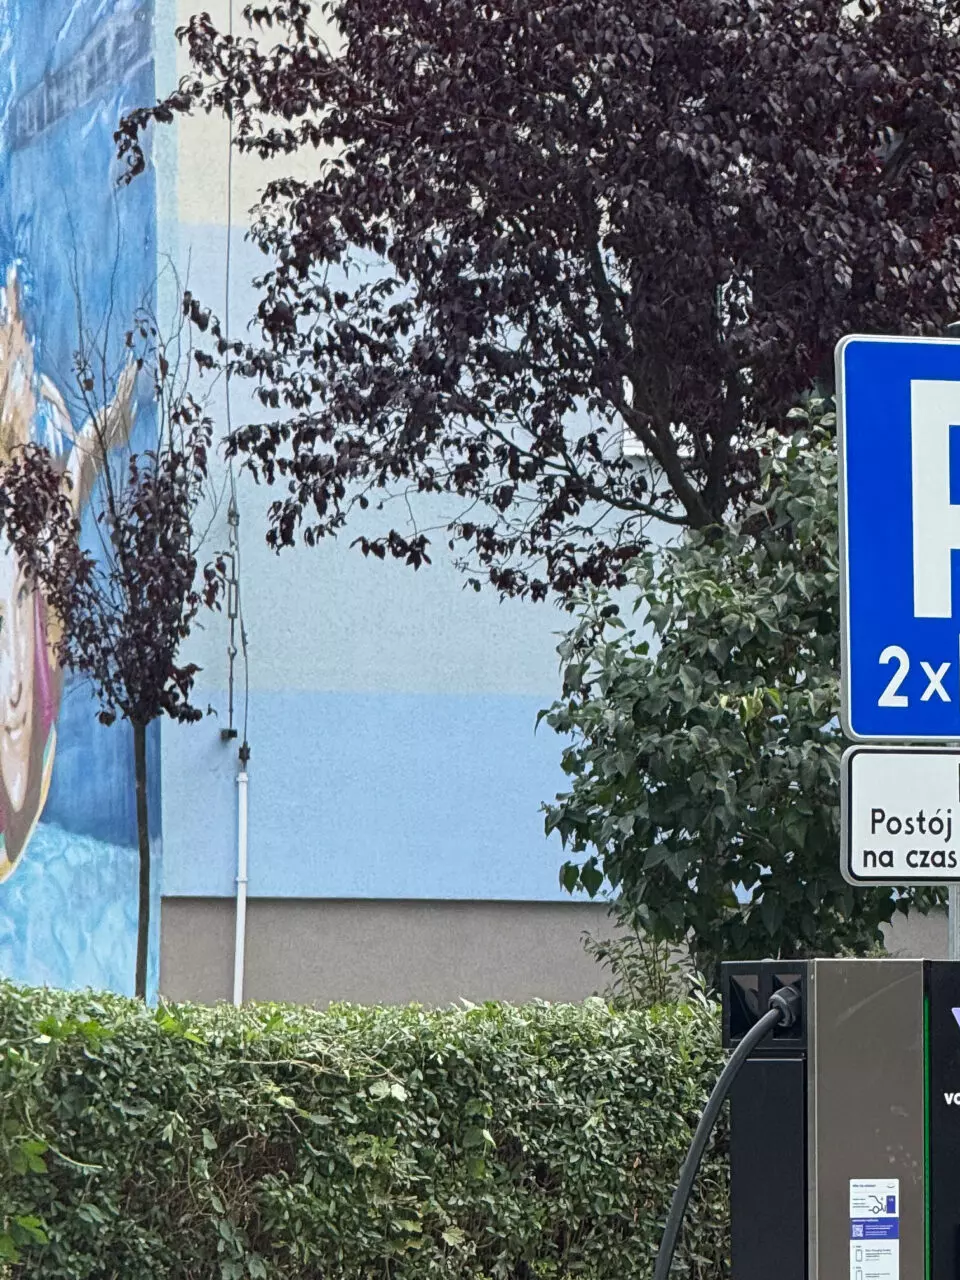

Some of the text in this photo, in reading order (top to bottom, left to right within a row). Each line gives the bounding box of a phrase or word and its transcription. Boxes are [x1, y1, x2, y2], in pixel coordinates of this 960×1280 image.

[871, 808, 952, 843] Postój
[863, 850, 894, 868] na
[905, 850, 958, 868] czas
